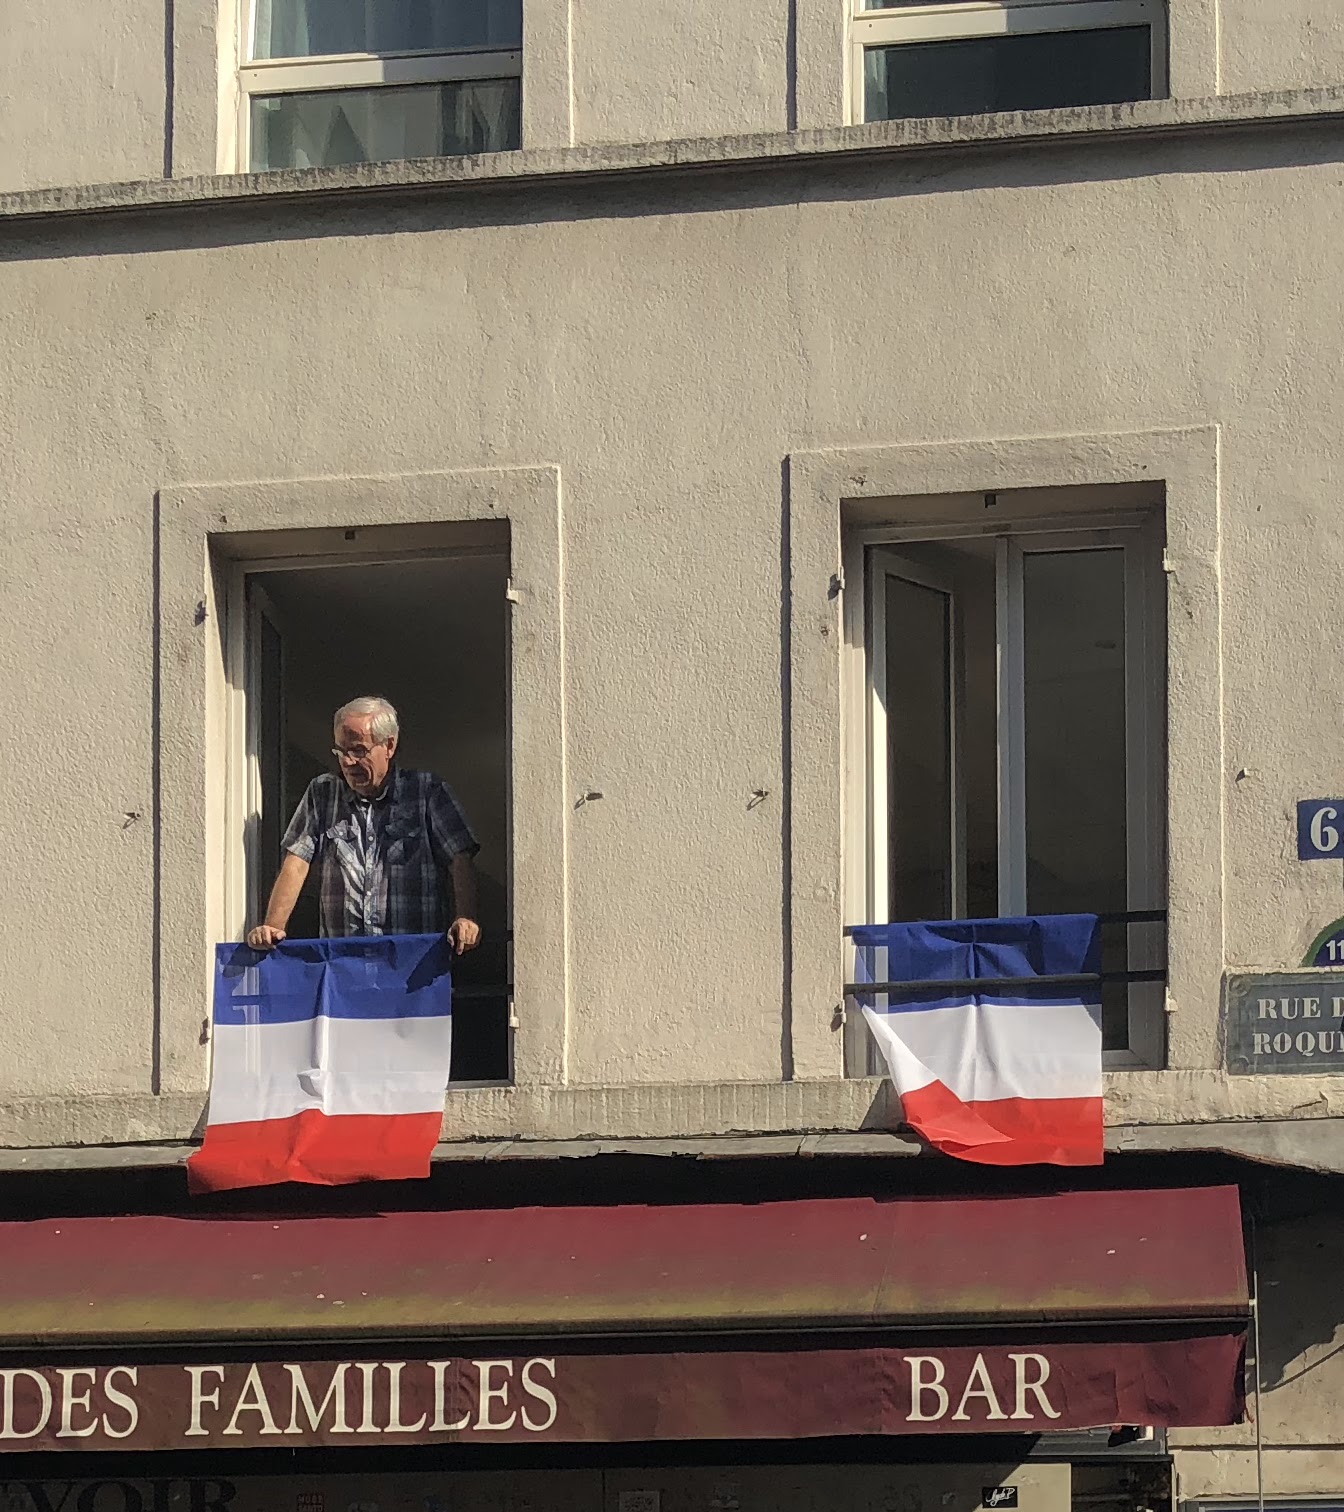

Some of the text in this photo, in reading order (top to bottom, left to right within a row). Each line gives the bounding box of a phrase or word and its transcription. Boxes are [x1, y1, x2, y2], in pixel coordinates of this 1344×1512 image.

[1257, 997, 1321, 1020] RUE
[184, 1357, 558, 1437] FAMILLES
[903, 1353, 1063, 1422] BAR
